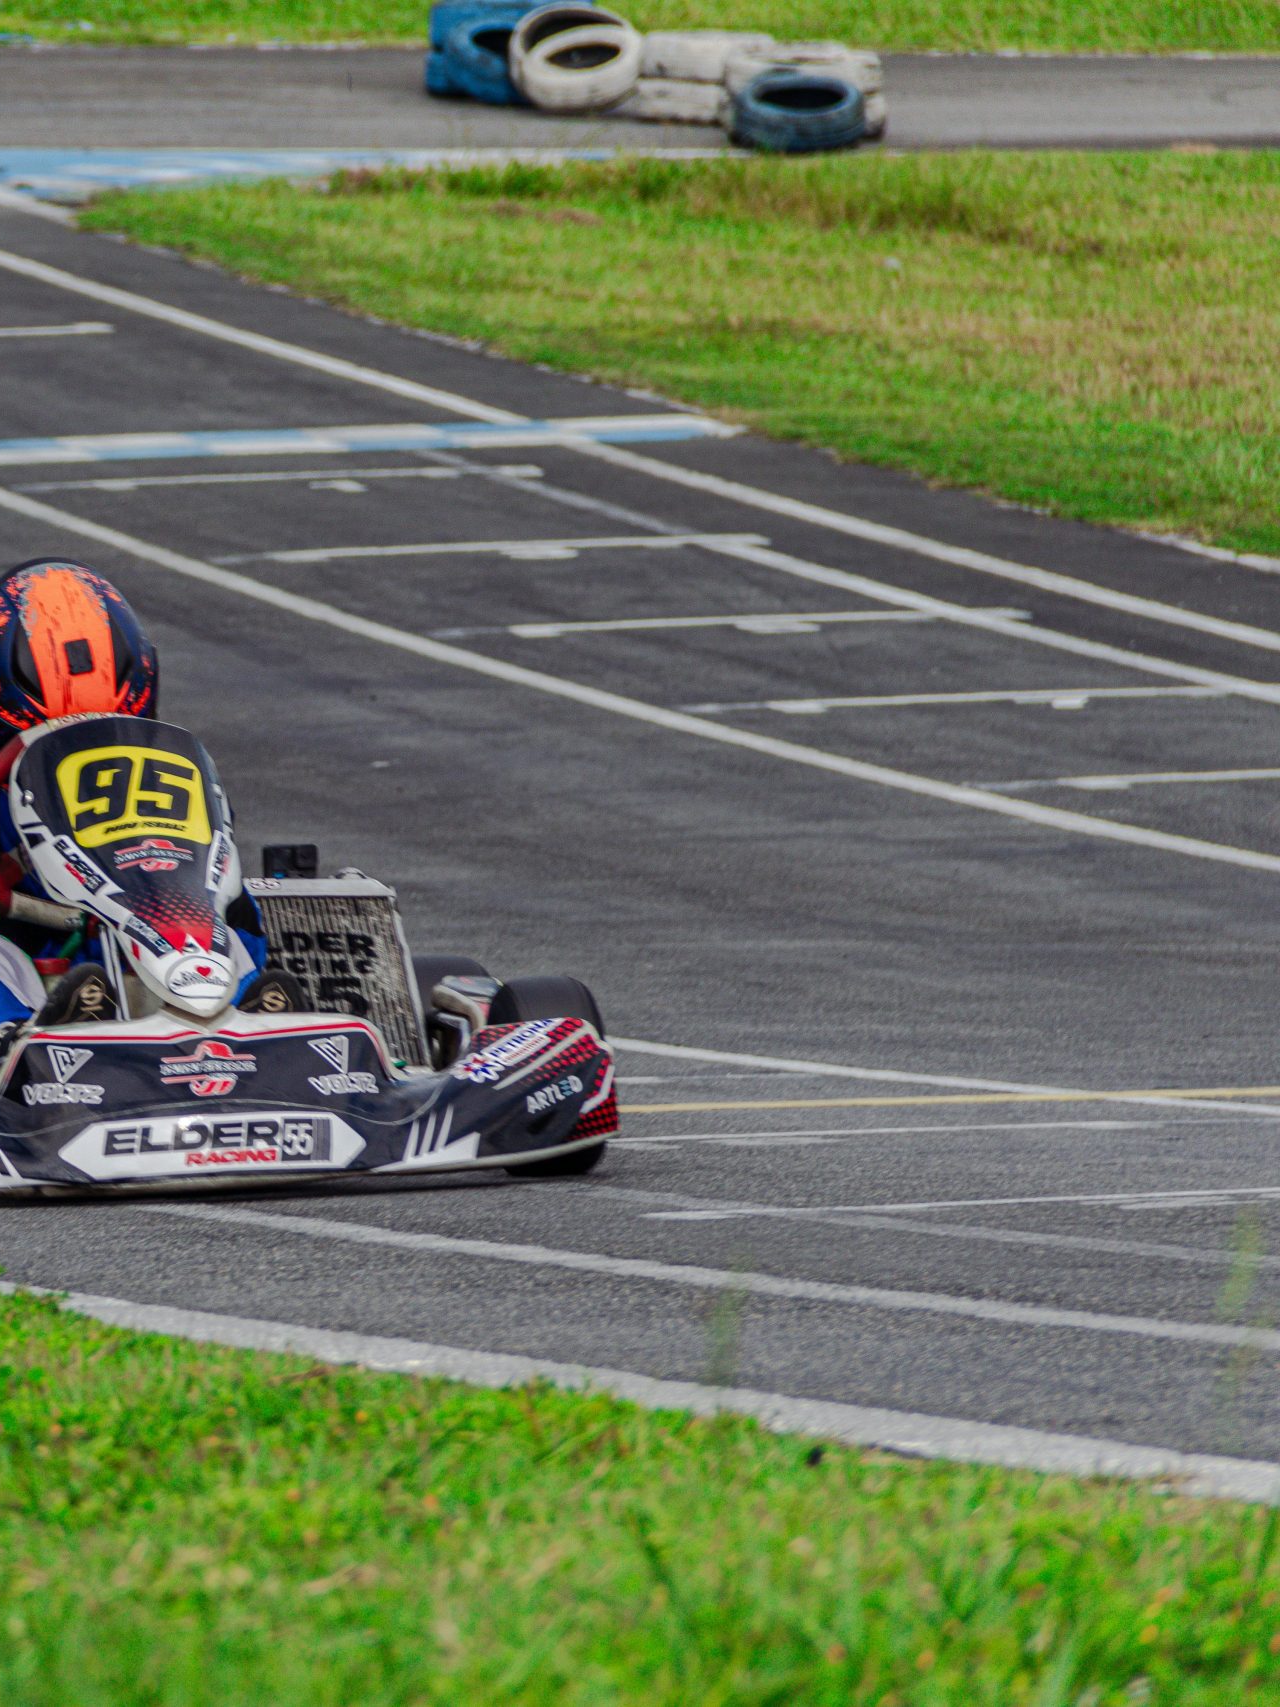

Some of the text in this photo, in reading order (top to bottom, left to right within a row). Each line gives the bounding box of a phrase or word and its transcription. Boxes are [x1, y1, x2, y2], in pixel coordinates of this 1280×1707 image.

[75, 756, 194, 831] 95
[104, 1120, 315, 1156] ELDER 55
[185, 1149, 276, 1167] RACING
